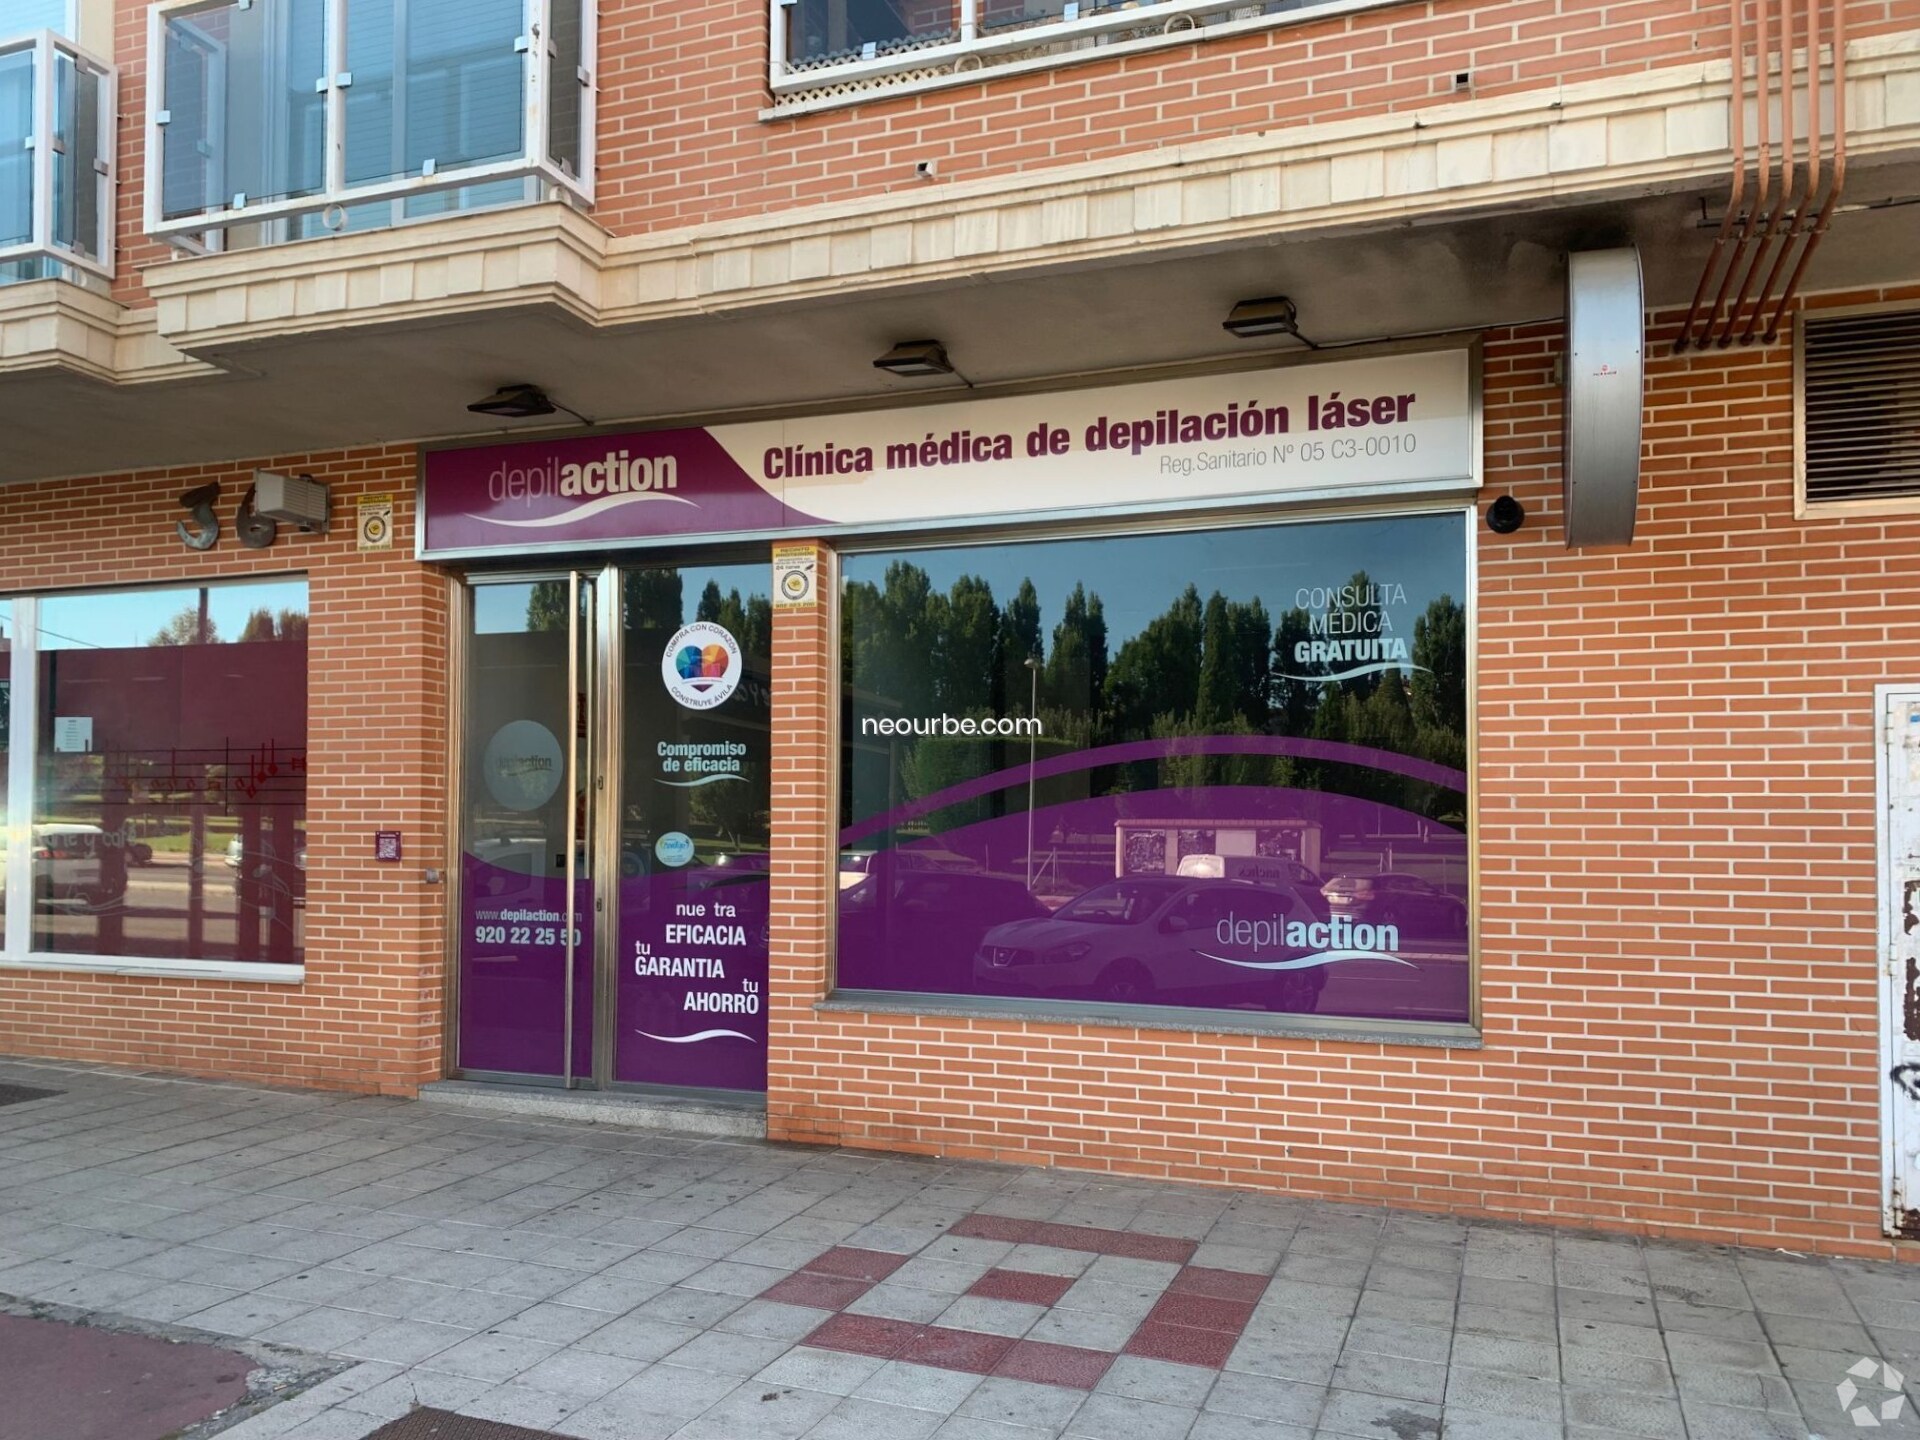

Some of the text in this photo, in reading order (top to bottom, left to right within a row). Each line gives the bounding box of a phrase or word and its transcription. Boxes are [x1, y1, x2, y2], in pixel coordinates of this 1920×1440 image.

[763, 391, 1416, 479] Clínica médica de depilación láser
[1300, 442, 1325, 462] 05
[1331, 433, 1416, 459] C3-0010
[488, 450, 678, 508] depilaction
[1295, 583, 1407, 610] CONSULTA
[1310, 609, 1393, 635] MÉDICA
[666, 629, 690, 658] COMPRA
[690, 624, 707, 632] CON
[1294, 638, 1408, 663] GRATUITA
[671, 686, 713, 707] CONSTRUYE
[657, 741, 746, 758] Compromiso
[663, 757, 740, 772] de eficacia
[475, 908, 583, 923] www.depilaction.cm
[475, 926, 506, 944] 920
[510, 927, 531, 945] 22
[535, 927, 555, 945] 25
[665, 924, 747, 946] EFICACIA
[1216, 911, 1399, 951] depilaction
[635, 940, 651, 955] tu
[635, 956, 725, 978] GARANTIA
[742, 978, 759, 993] tu
[683, 991, 759, 1014] AHORRO
